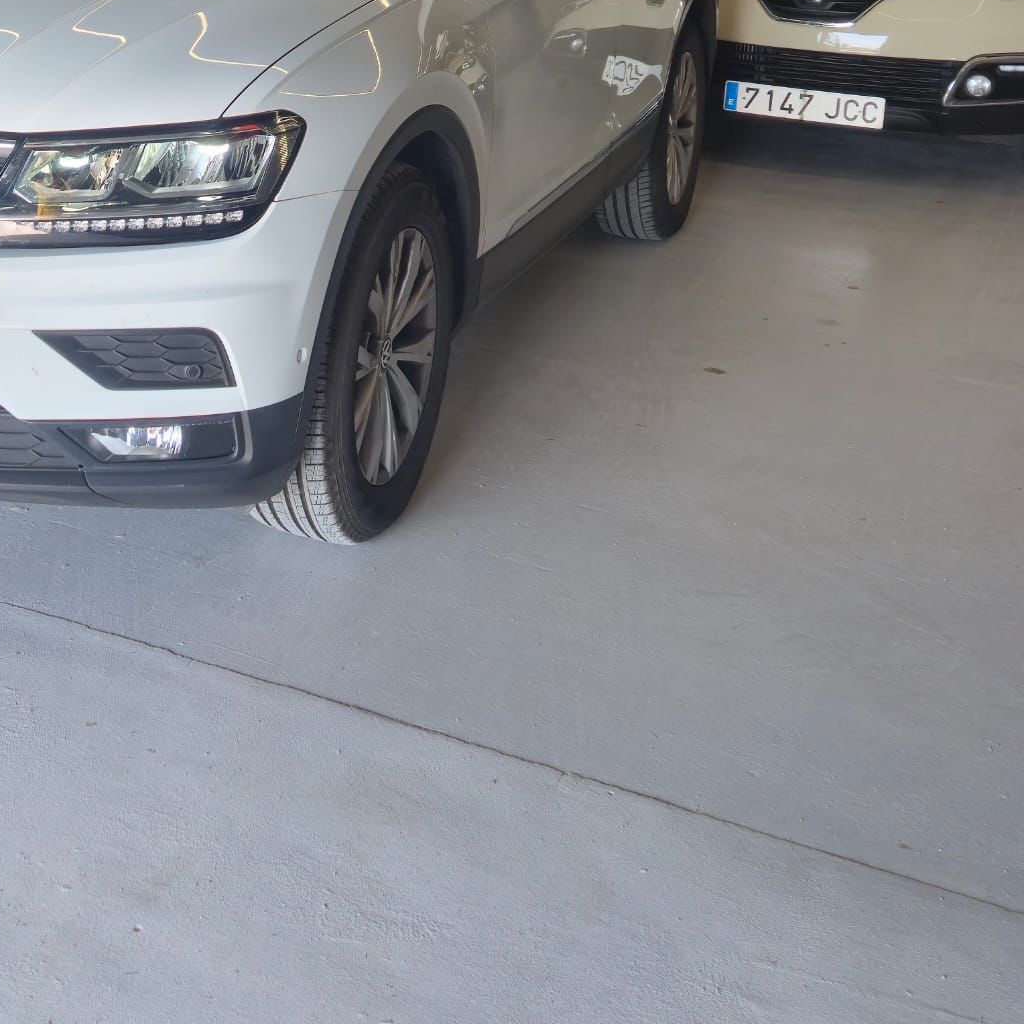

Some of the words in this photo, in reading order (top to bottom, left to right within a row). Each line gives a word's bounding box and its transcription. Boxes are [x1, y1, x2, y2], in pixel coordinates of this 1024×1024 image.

[728, 98, 735, 106] E
[743, 86, 814, 116] 7147
[825, 97, 878, 124] JCC
